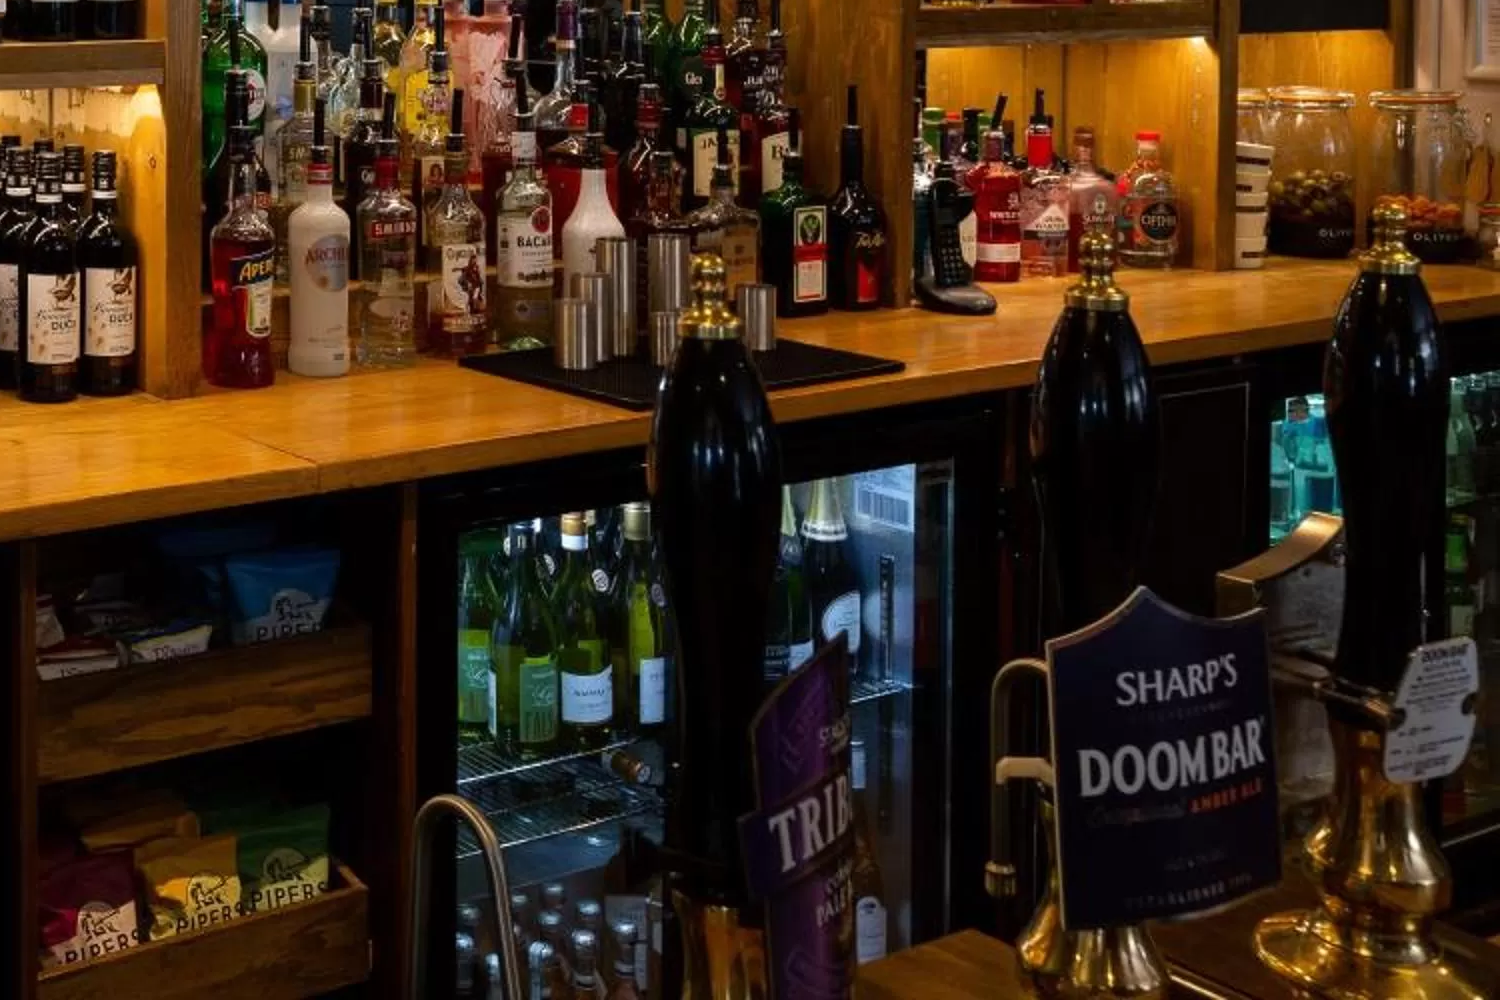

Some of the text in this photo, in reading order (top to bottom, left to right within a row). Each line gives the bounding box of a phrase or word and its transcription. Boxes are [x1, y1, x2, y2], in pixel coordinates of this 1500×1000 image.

[1115, 653, 1238, 706] SHARP'S
[1078, 719, 1266, 798] DOOM BAR
[1188, 776, 1262, 815] AMBER ALE
[768, 775, 852, 873] TRIB
[251, 880, 329, 913] PIPERS
[176, 901, 244, 935] PIPERS
[65, 928, 141, 964] PIPERS
